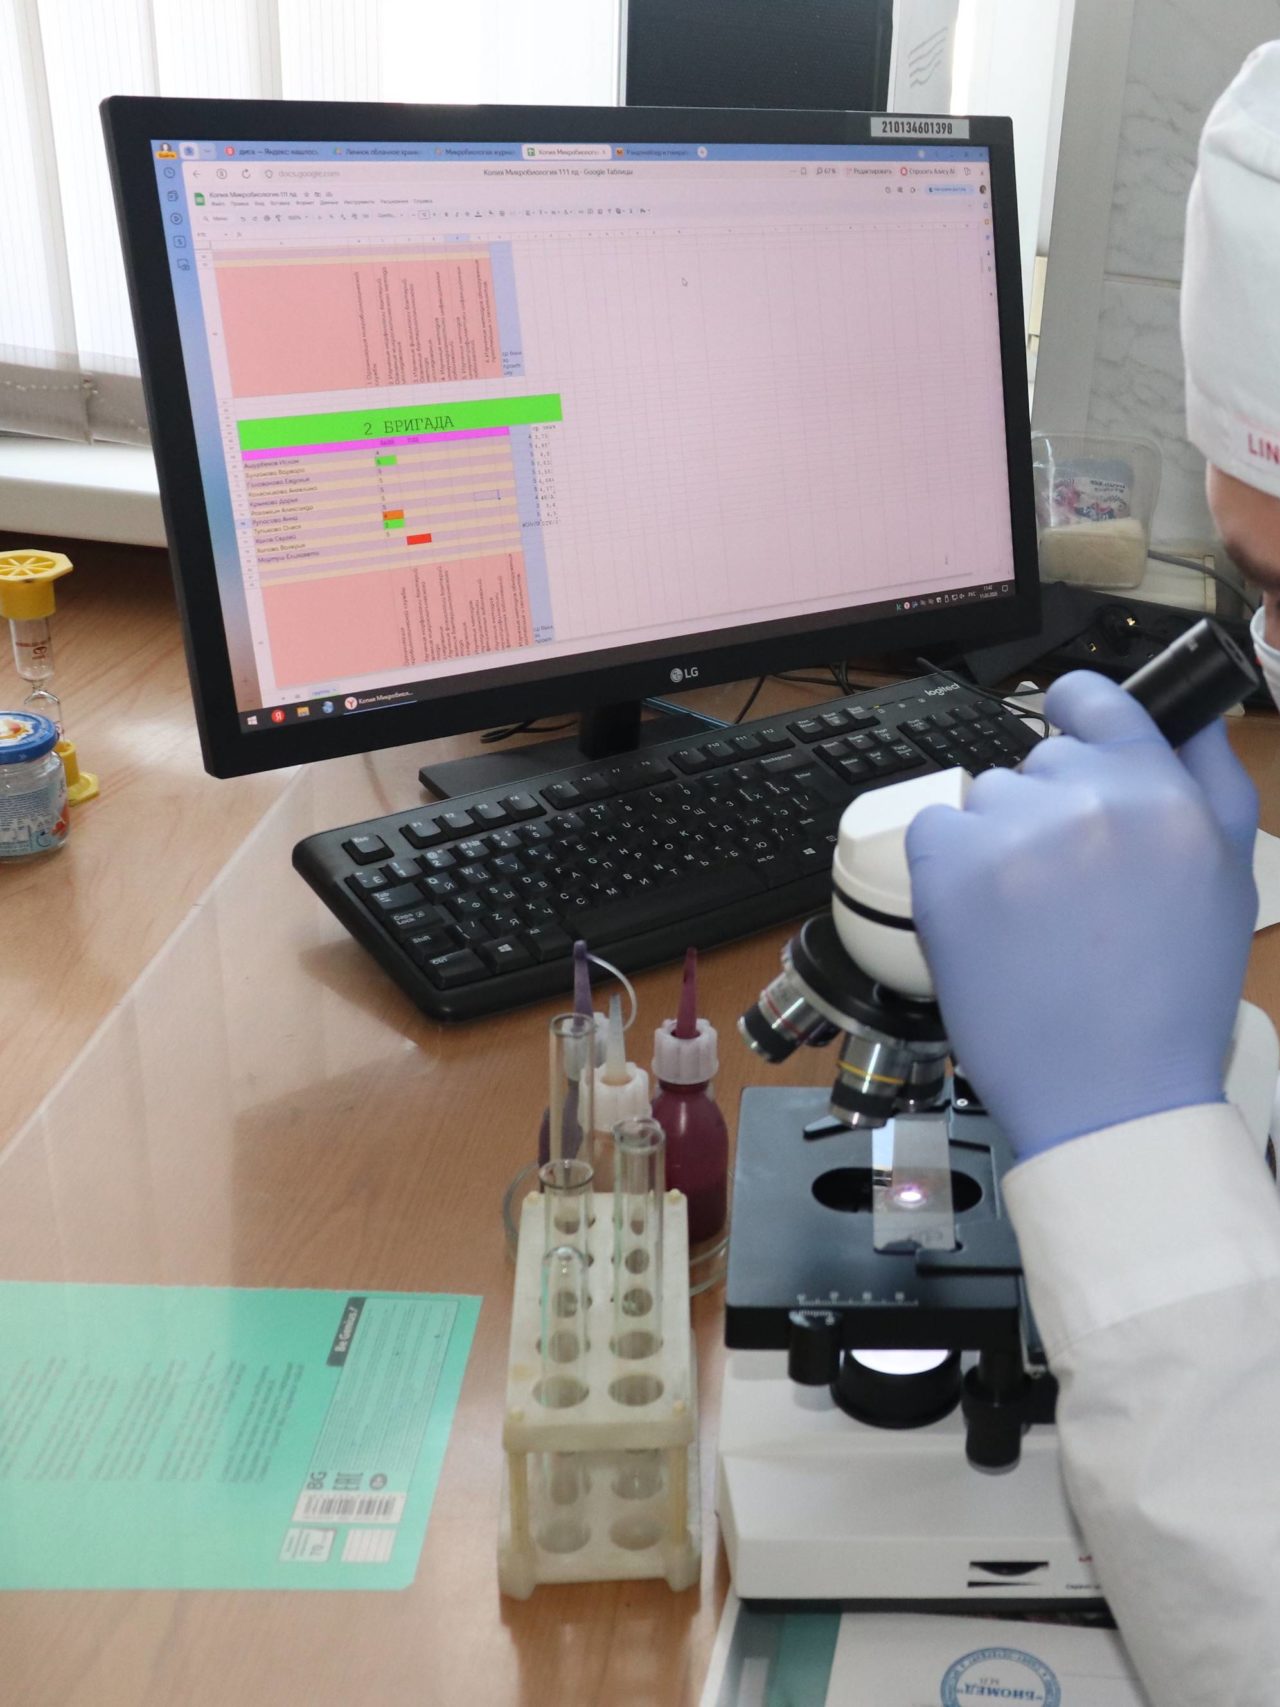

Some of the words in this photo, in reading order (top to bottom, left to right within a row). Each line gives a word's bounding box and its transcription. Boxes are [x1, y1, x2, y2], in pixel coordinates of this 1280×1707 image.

[882, 120, 953, 135] 210134601398
[278, 170, 340, 179] docs.google.com
[505, 168, 558, 177] Микробиология
[584, 168, 606, 177] Google
[364, 422, 373, 436] 2
[384, 416, 454, 434] БРИГАДА
[684, 666, 699, 678] LG
[694, 808, 706, 816] Щ
[666, 817, 677, 826] Ш
[722, 824, 734, 832] Д
[608, 834, 617, 842] Н
[756, 841, 768, 849] Ю
[466, 850, 475, 858] 3
[619, 848, 628, 856] H
[639, 878, 650, 886] И
[503, 890, 516, 899] Ы
[606, 886, 618, 896] М
[510, 918, 520, 926] Я
[412, 935, 432, 944] Shift
[430, 956, 448, 965] Ctrl
[338, 1306, 358, 1340] Genius!
